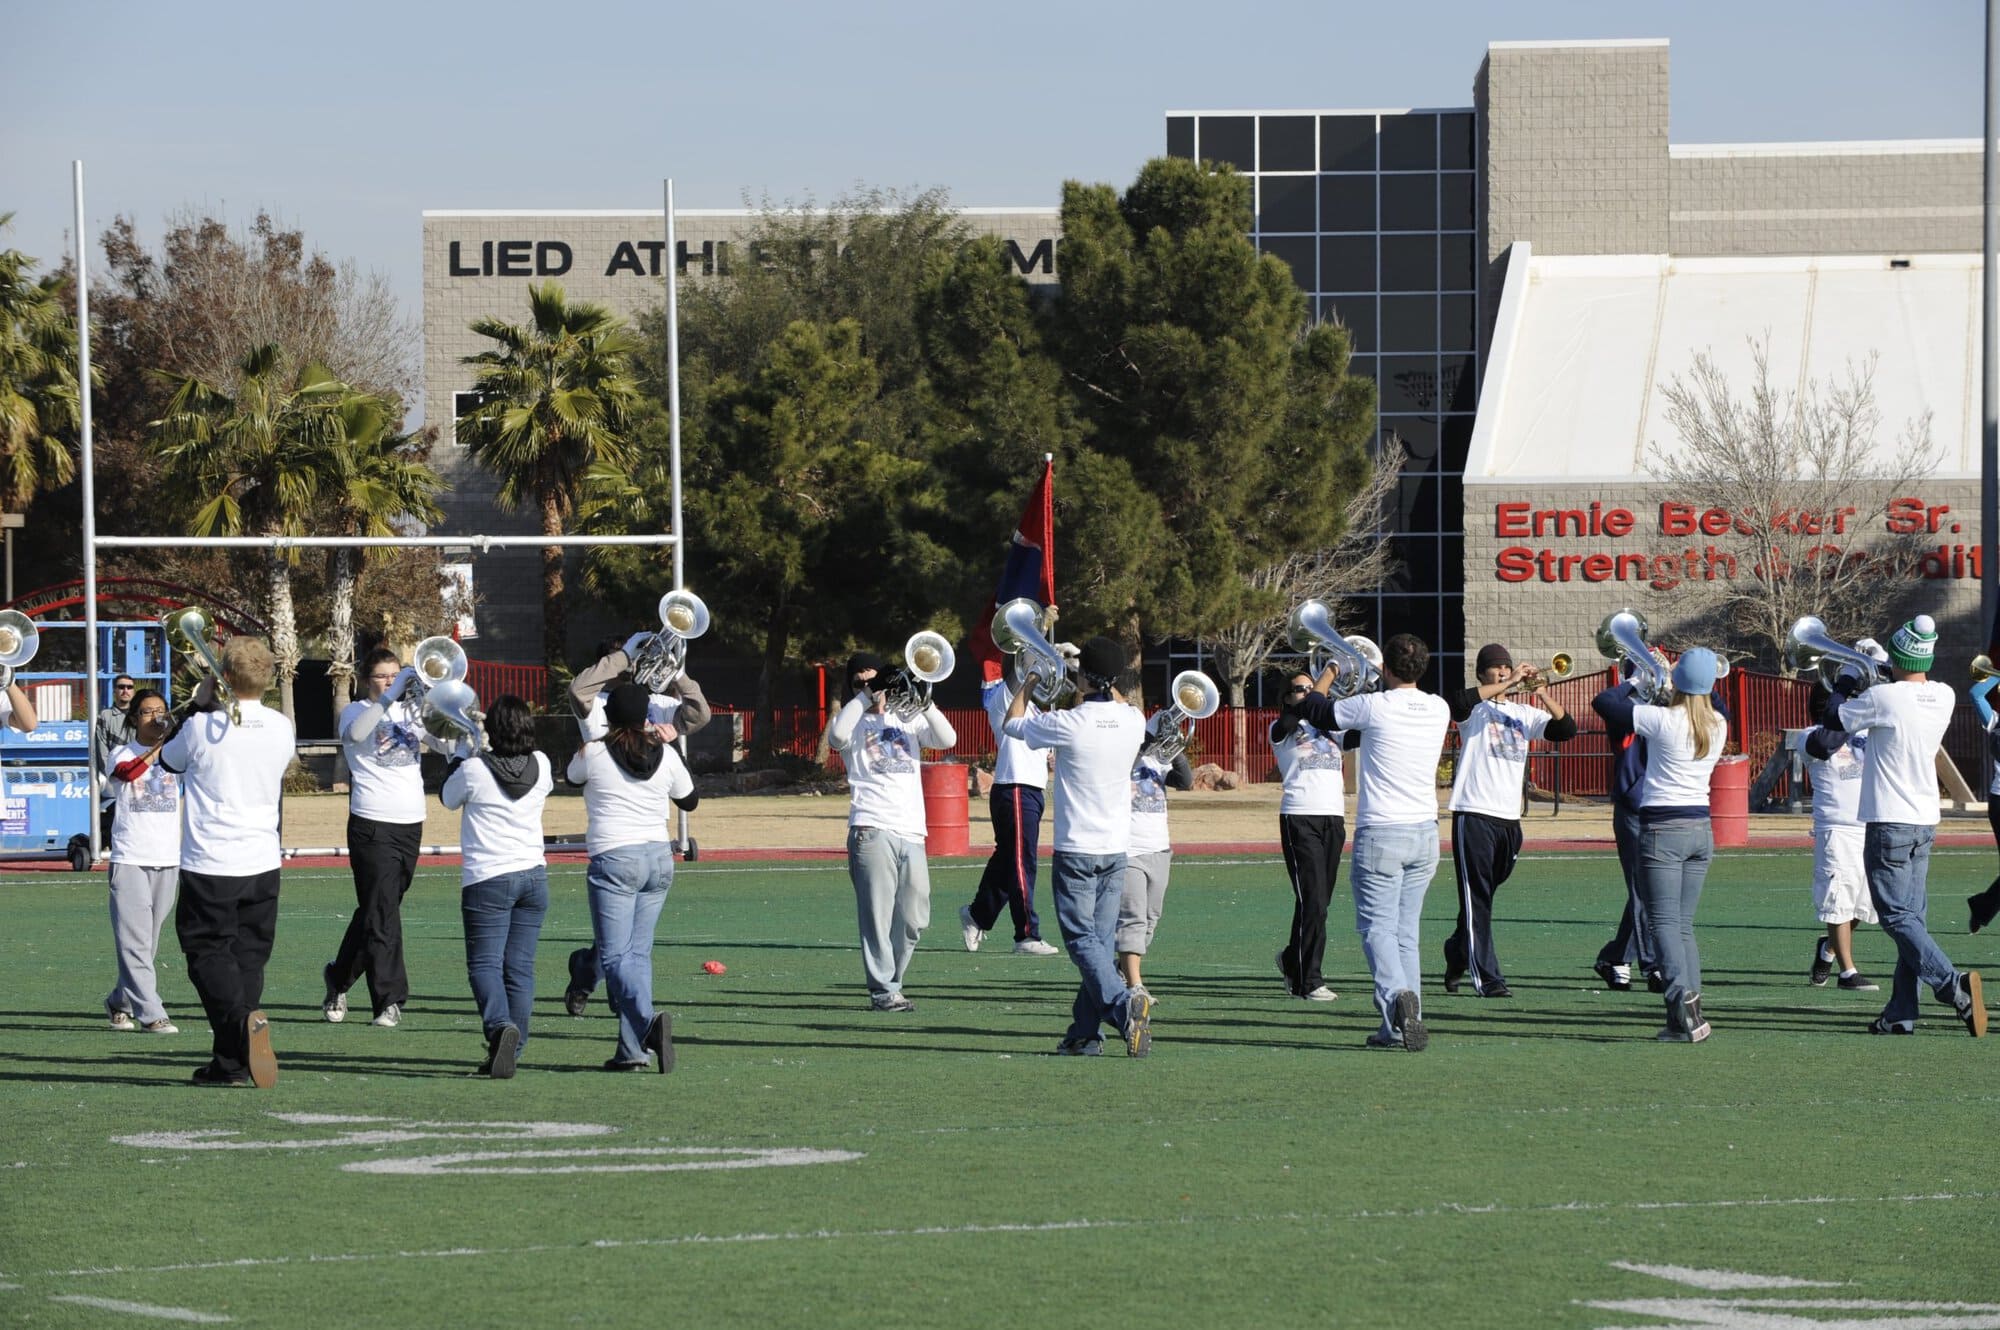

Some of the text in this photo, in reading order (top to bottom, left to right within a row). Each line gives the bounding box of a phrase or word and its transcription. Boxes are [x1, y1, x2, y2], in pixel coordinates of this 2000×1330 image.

[449, 240, 573, 277] LIED
[1496, 501, 1635, 537] Ernie
[1887, 497, 1961, 534] Sr.
[1496, 545, 1737, 590] Strength
[26, 729, 89, 742] Genie GS-
[60, 782, 90, 798] 4x4
